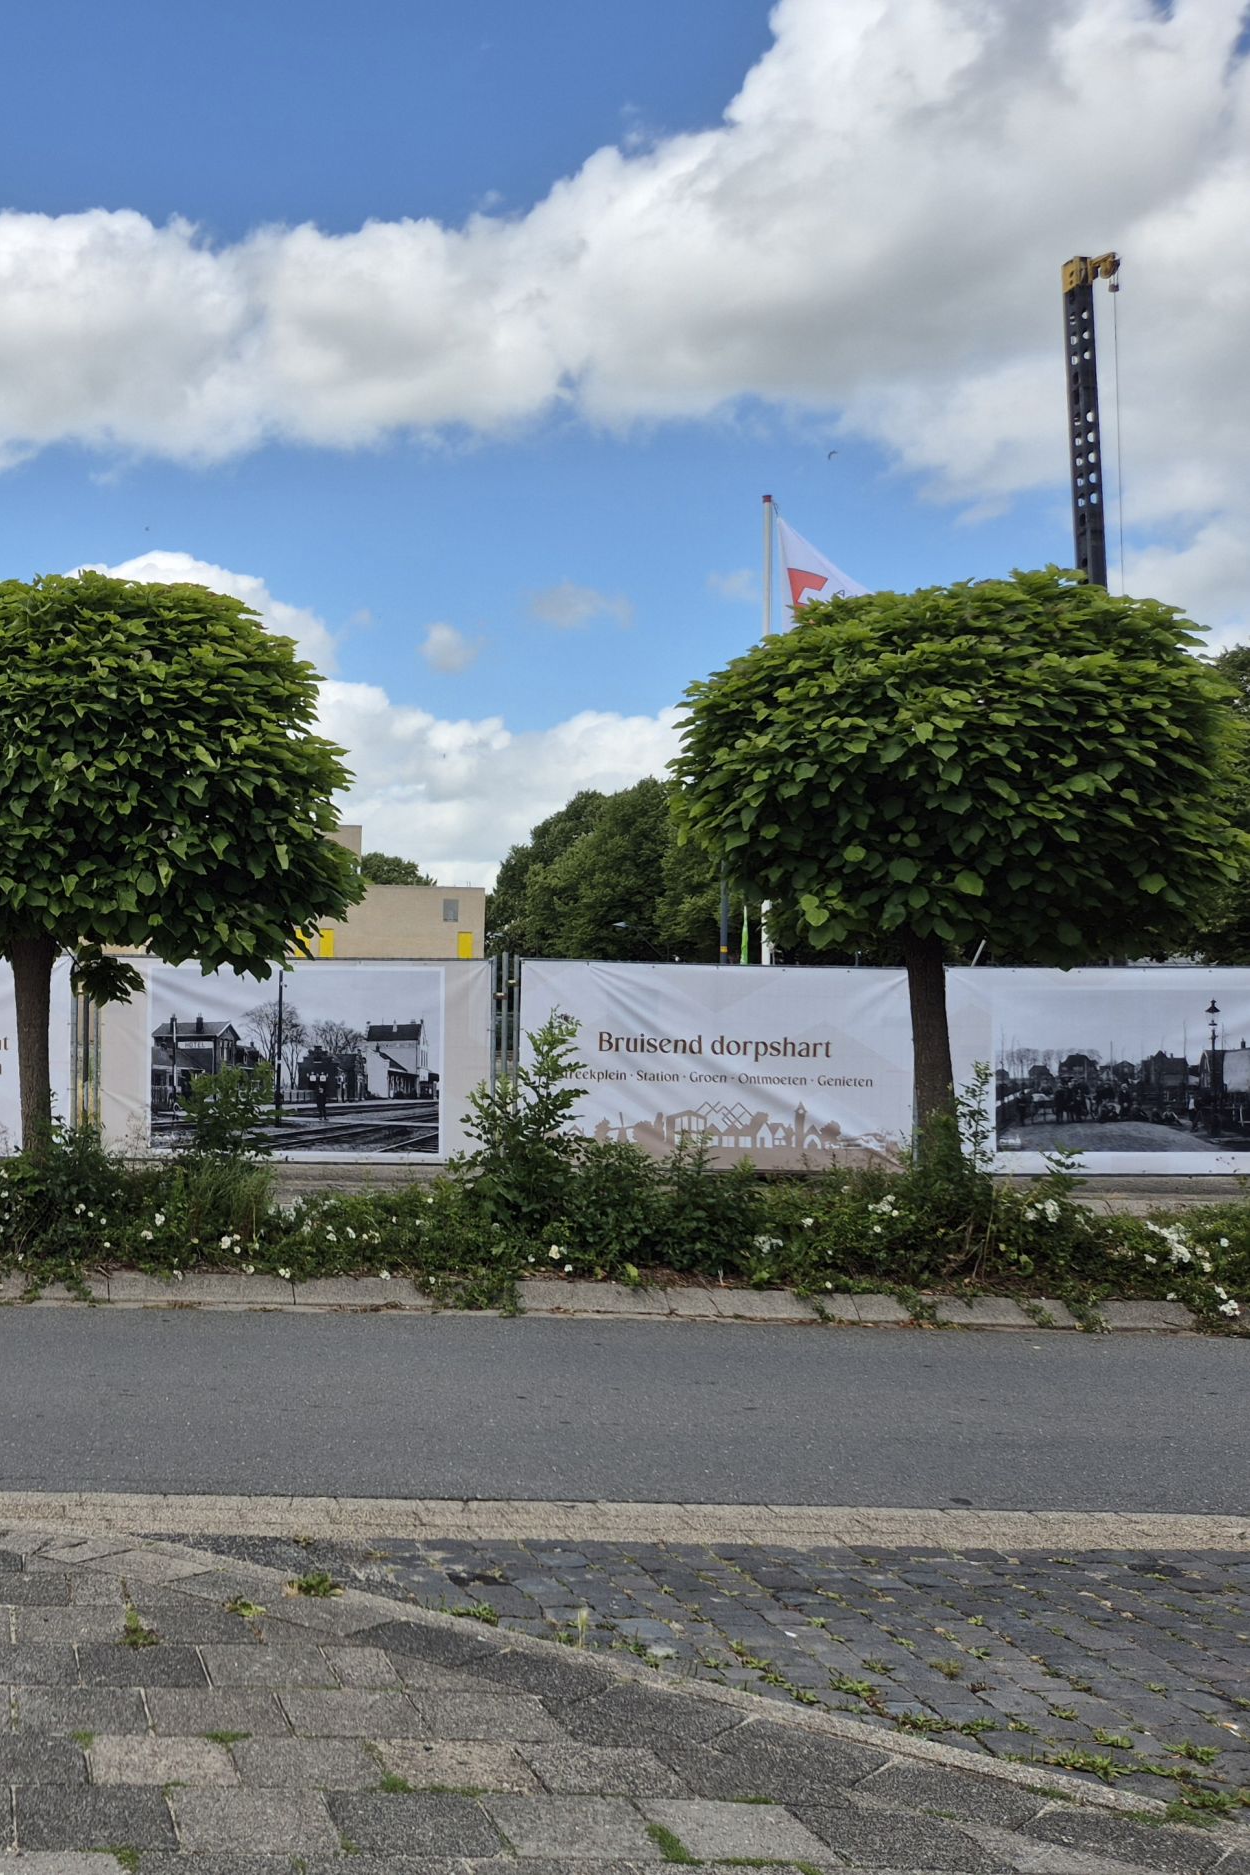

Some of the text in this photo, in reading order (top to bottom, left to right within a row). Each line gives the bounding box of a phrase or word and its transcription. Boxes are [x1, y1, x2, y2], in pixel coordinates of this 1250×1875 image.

[598, 1031, 832, 1062] Bruisend dorpshart
[564, 1068, 874, 1089] treekplein Station Groen Ontmoeten Genieten
